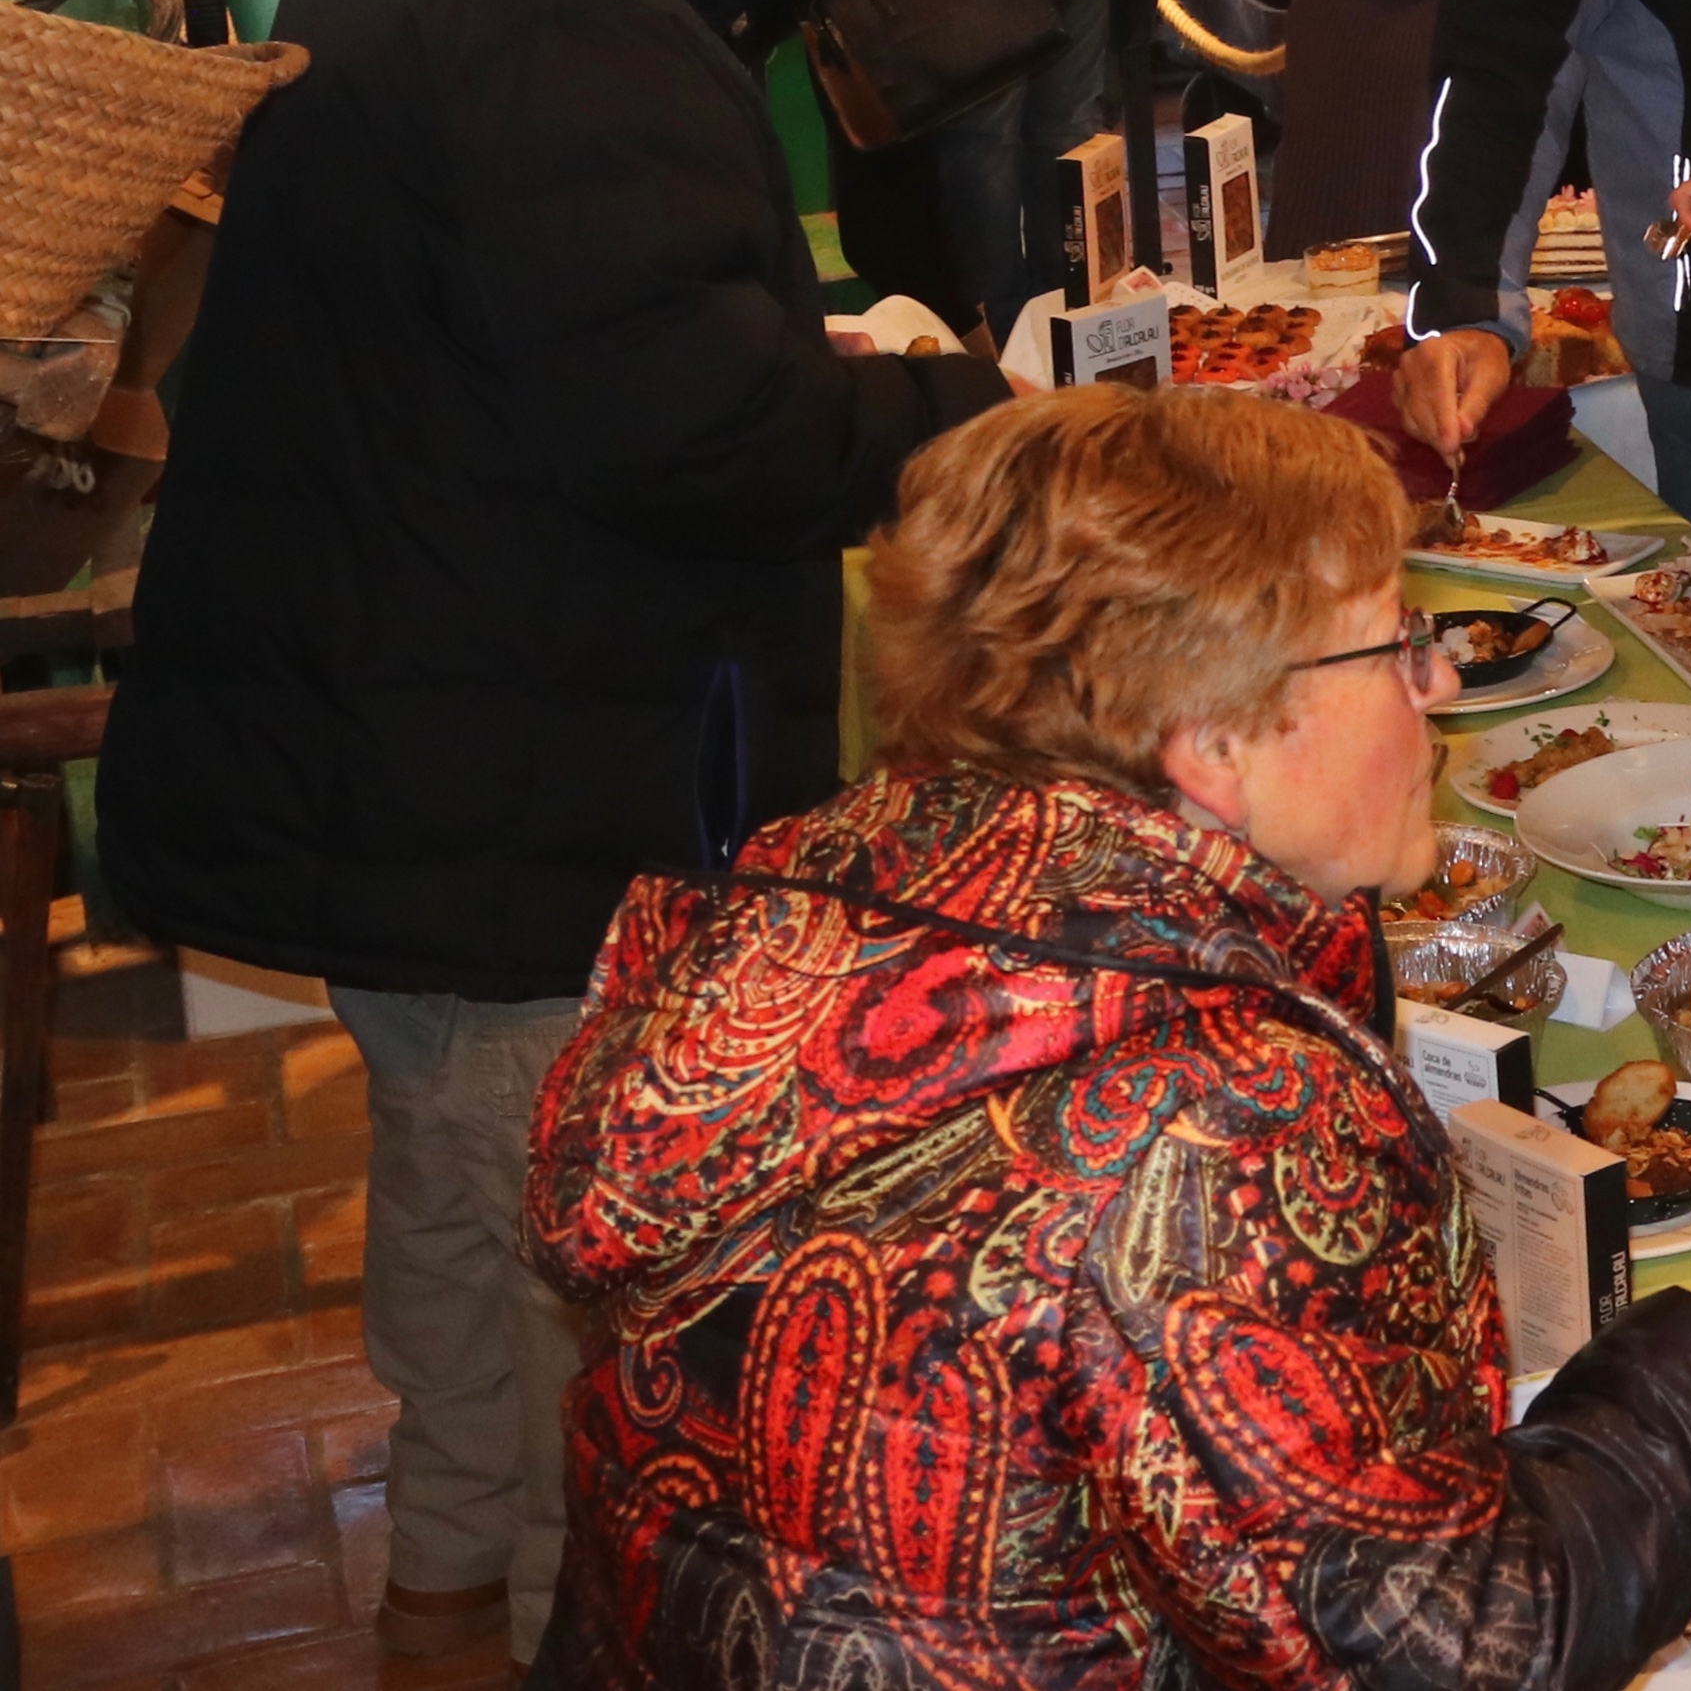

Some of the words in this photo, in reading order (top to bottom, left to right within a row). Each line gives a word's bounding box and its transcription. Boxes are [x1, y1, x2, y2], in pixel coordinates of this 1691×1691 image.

[1422, 1050, 1440, 1063] Coca
[1442, 1055, 1451, 1066] de
[1424, 1063, 1462, 1082] almendras
[1600, 1293, 1613, 1325] FLOR
